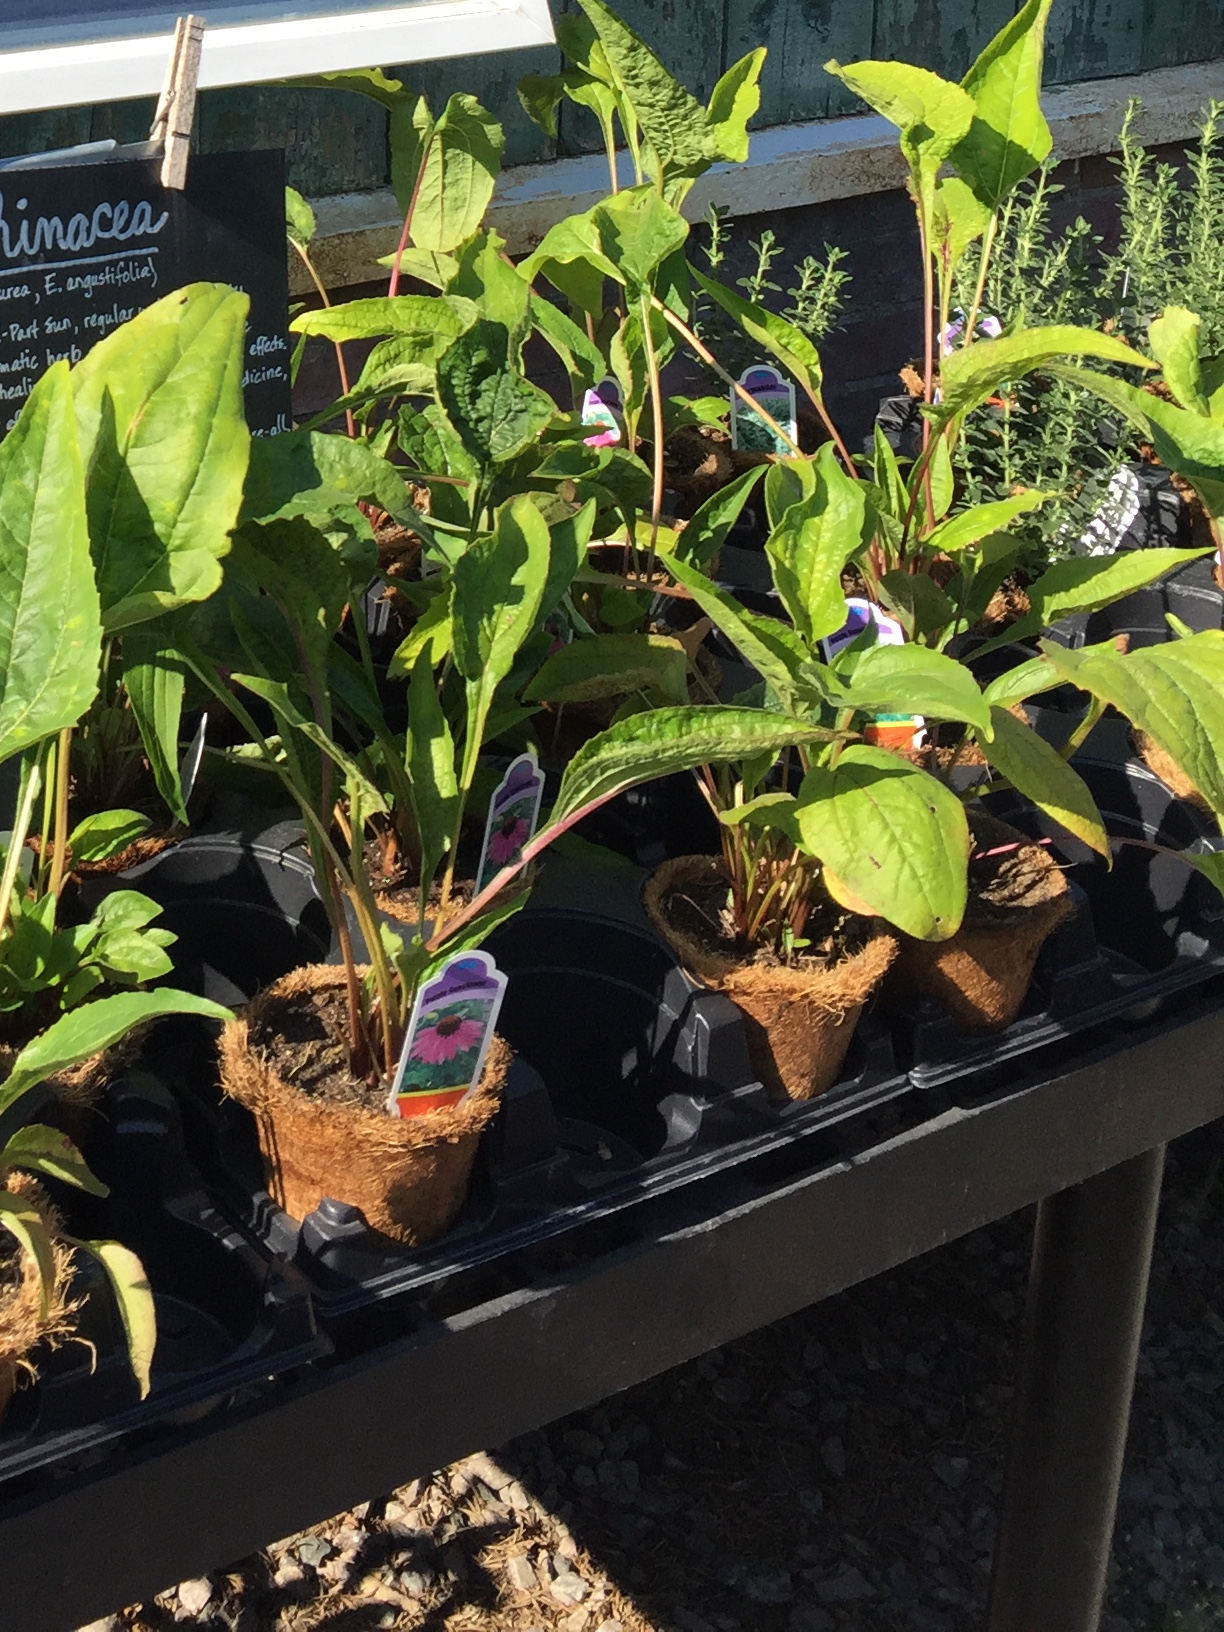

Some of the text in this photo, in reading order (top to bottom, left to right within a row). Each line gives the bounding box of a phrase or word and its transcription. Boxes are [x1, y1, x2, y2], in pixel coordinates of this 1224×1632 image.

[44, 273, 63, 296] E.
[66, 257, 158, 299] angustifolia)
[83, 303, 134, 335] regular
[242, 366, 288, 388] dicine,
